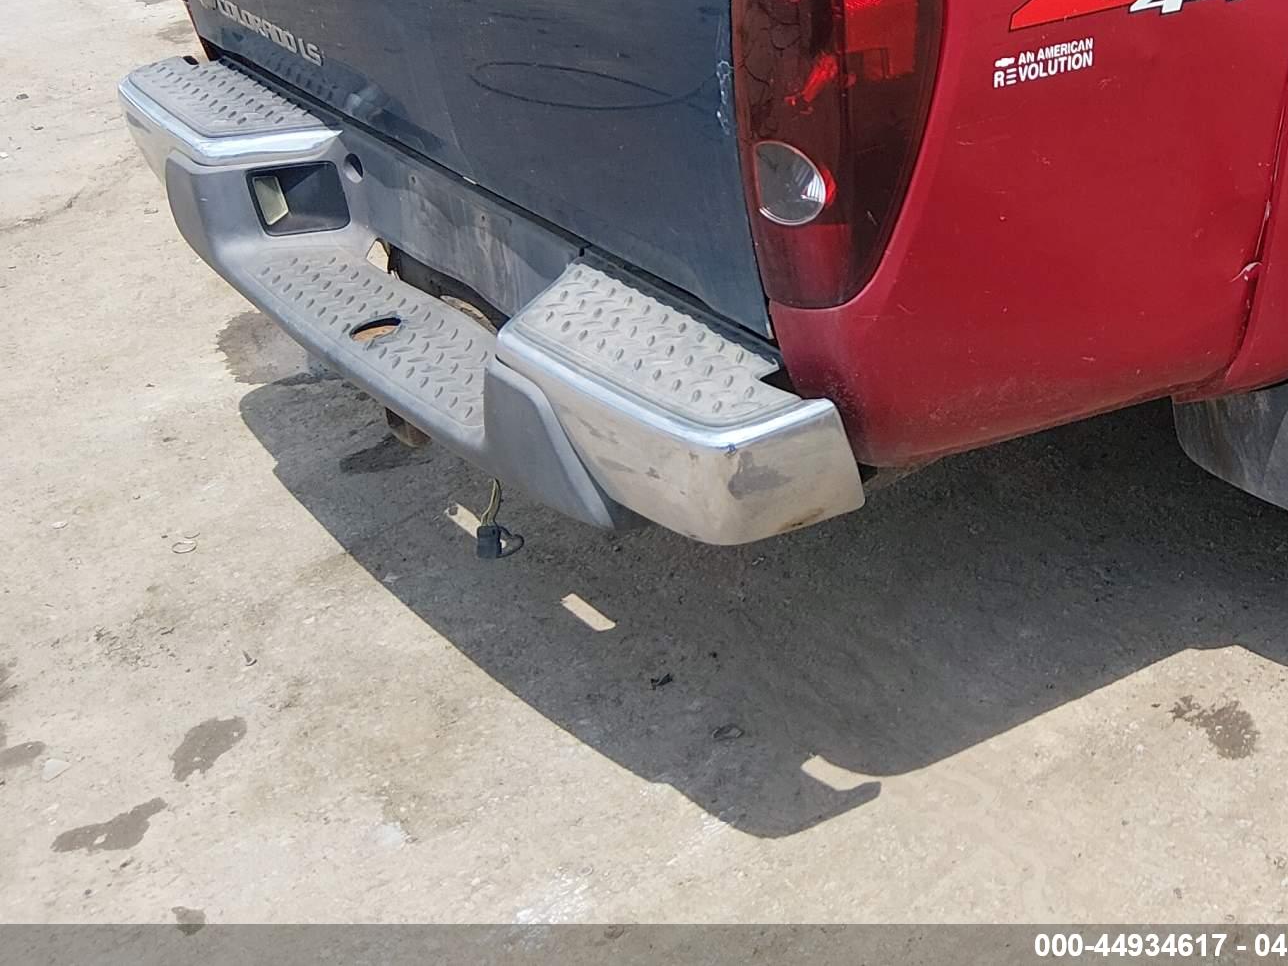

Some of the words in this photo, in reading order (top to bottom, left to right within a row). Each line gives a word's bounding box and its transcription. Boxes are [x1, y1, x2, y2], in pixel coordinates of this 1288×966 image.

[297, 37, 323, 67] LS
[1017, 50, 1035, 65] AN
[1036, 37, 1094, 61] AMERICAN
[992, 50, 1094, 89] REVOLUTION
